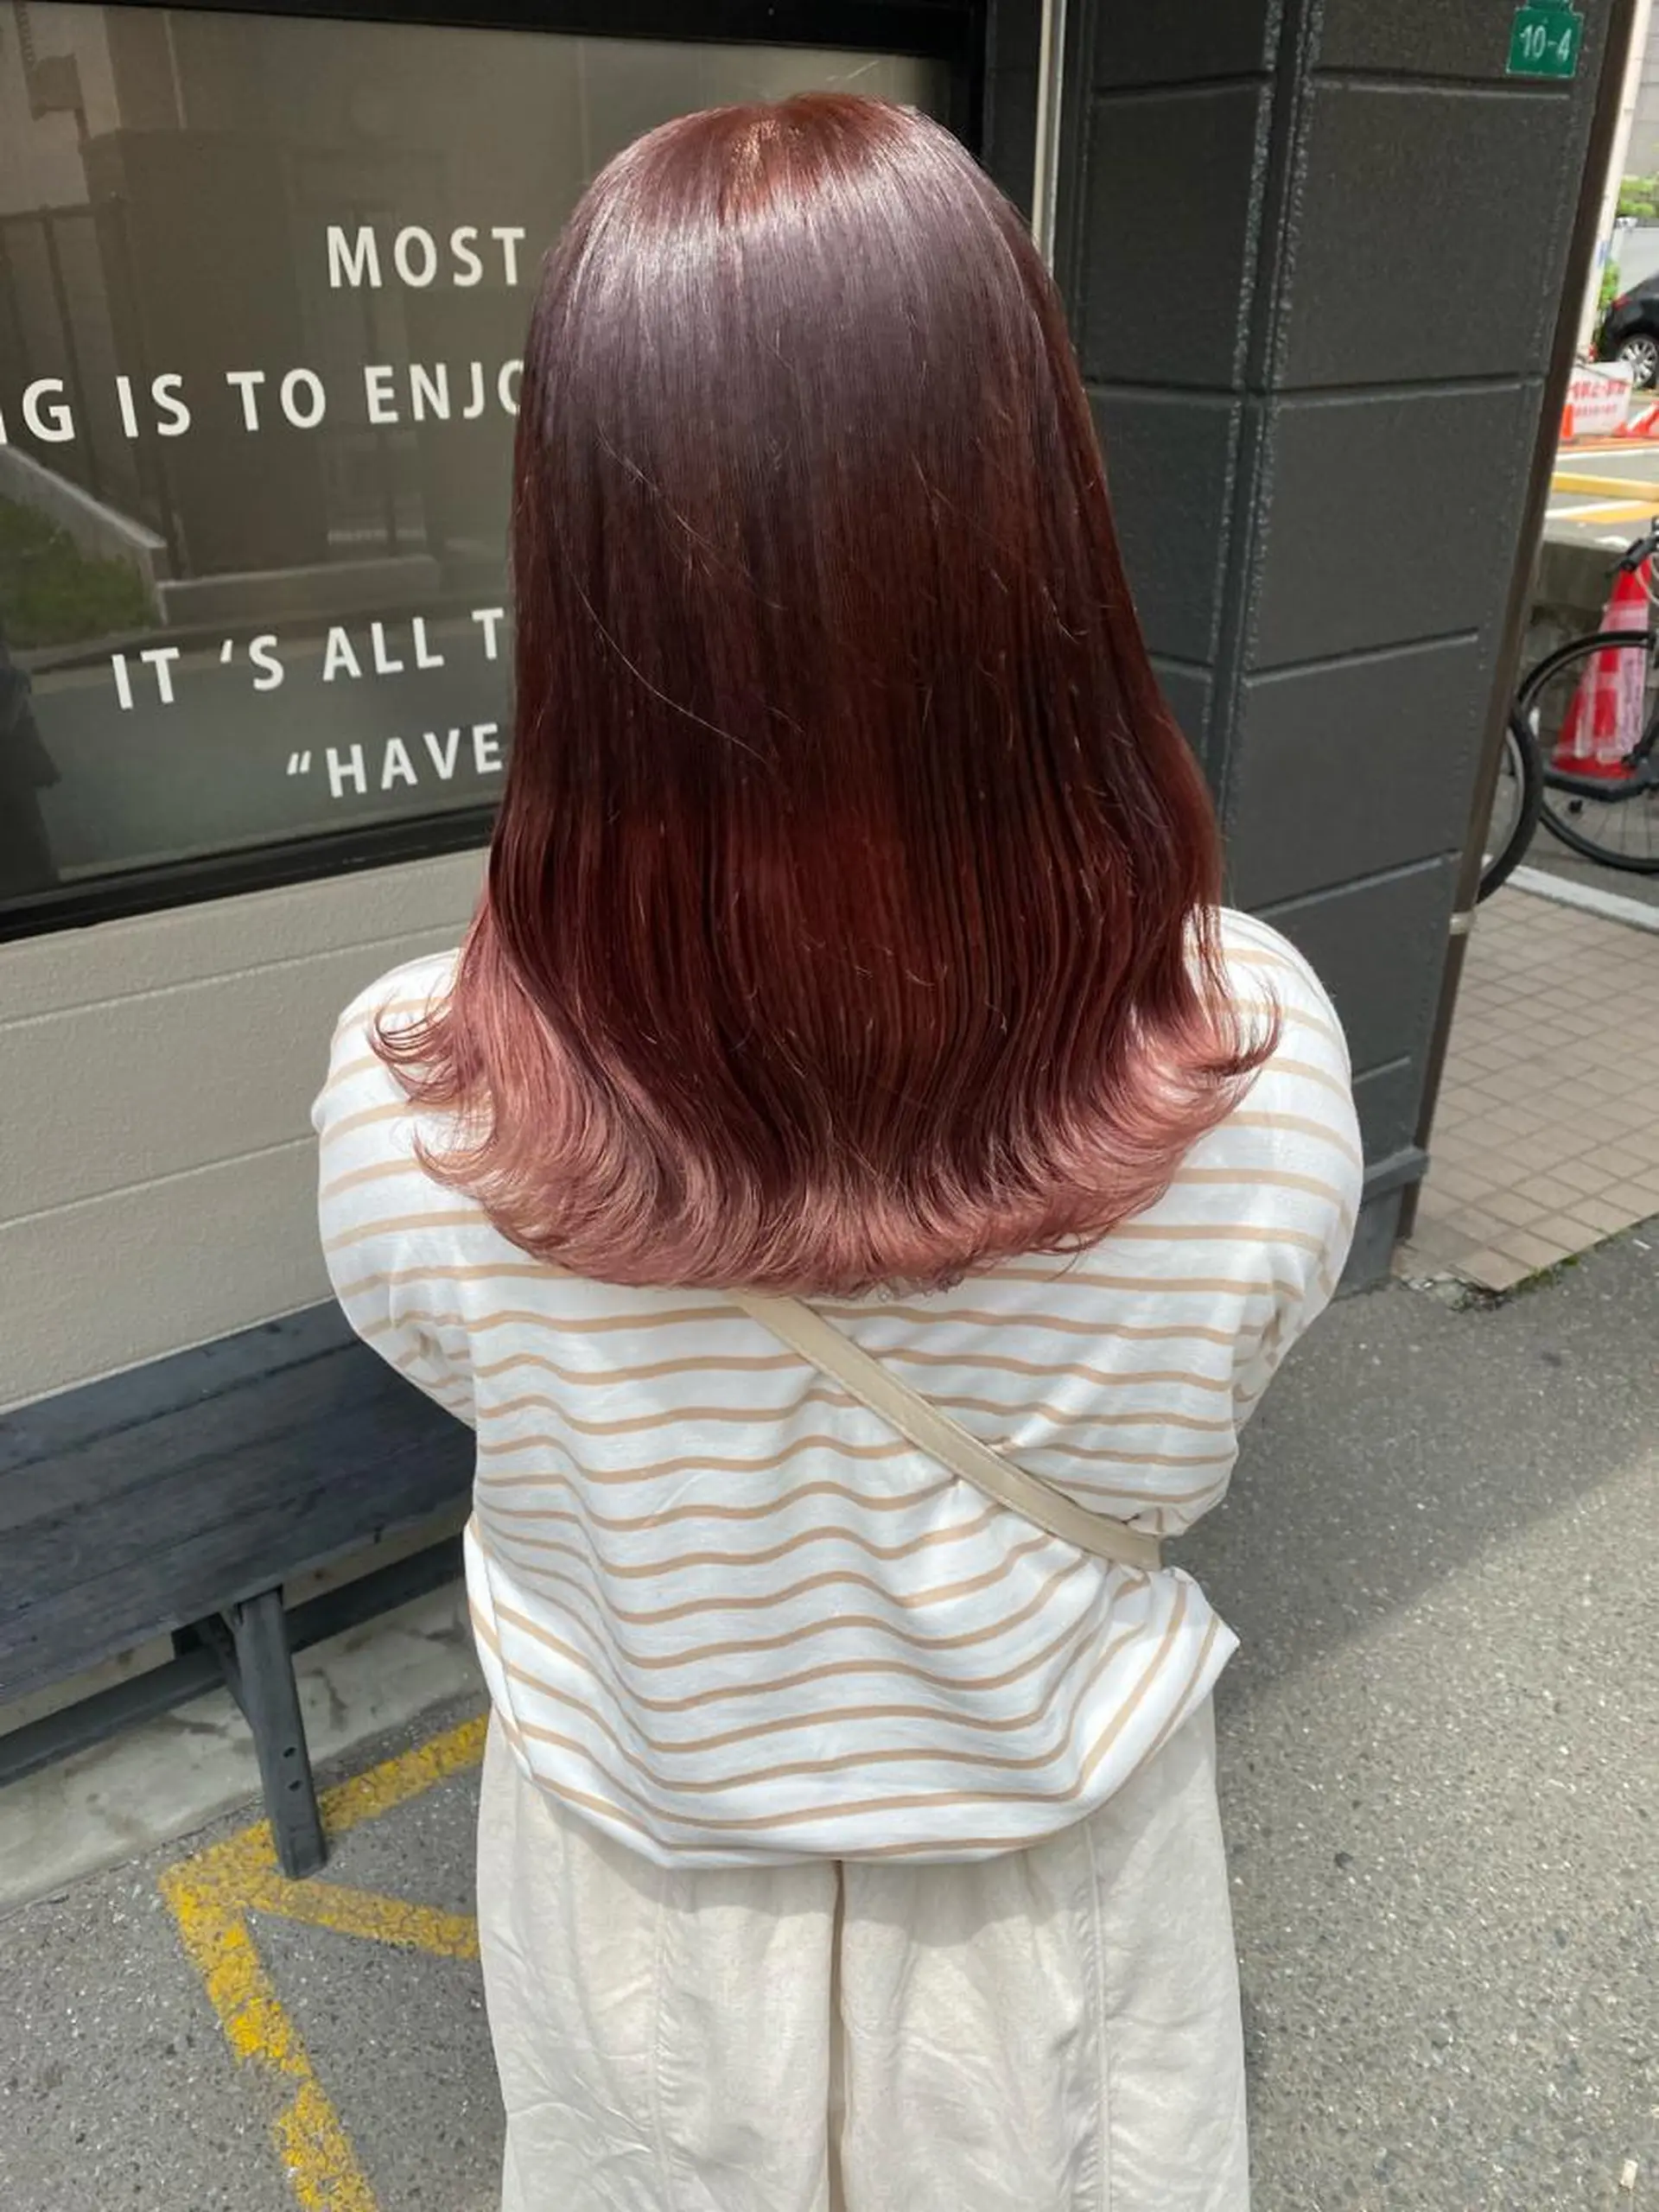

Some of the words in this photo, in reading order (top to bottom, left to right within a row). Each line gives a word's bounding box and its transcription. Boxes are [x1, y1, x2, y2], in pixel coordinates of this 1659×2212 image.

[1520, 24, 1572, 62] 10-4
[327, 225, 525, 289] MOST
[0, 378, 76, 445] G
[115, 373, 191, 438] IS
[226, 368, 327, 431] TO
[321, 617, 445, 682] ALL
